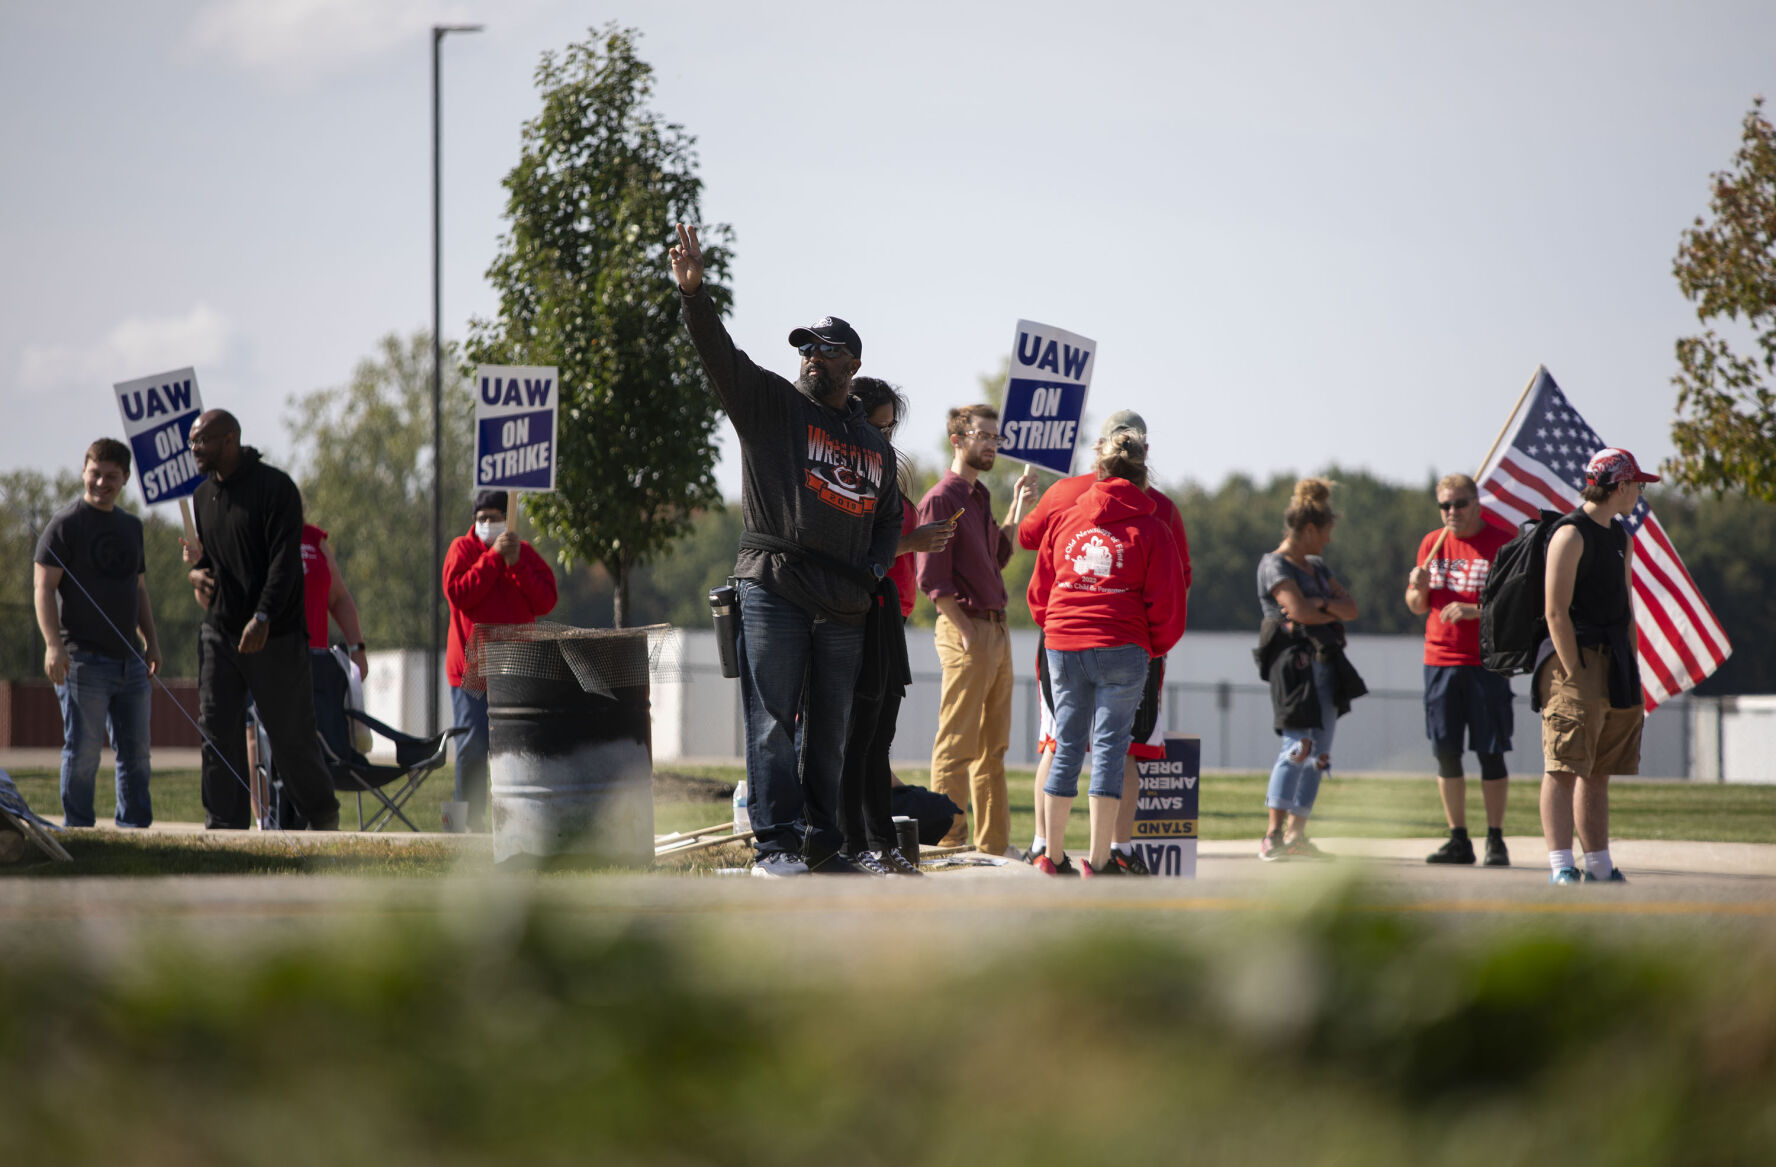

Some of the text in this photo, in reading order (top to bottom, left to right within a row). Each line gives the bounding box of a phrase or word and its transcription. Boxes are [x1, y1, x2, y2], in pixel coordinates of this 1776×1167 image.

[1017, 332, 1090, 381] UAW
[121, 380, 191, 422] UAW
[482, 377, 551, 407] UAW
[1030, 387, 1062, 417] ON
[155, 423, 184, 461] ON
[502, 417, 529, 449] ON
[1003, 420, 1076, 450] STRIKE
[143, 450, 199, 500] STRIK
[481, 441, 550, 483] STRIKE
[1138, 761, 1183, 774] DREA
[1137, 822, 1193, 834] STAND
